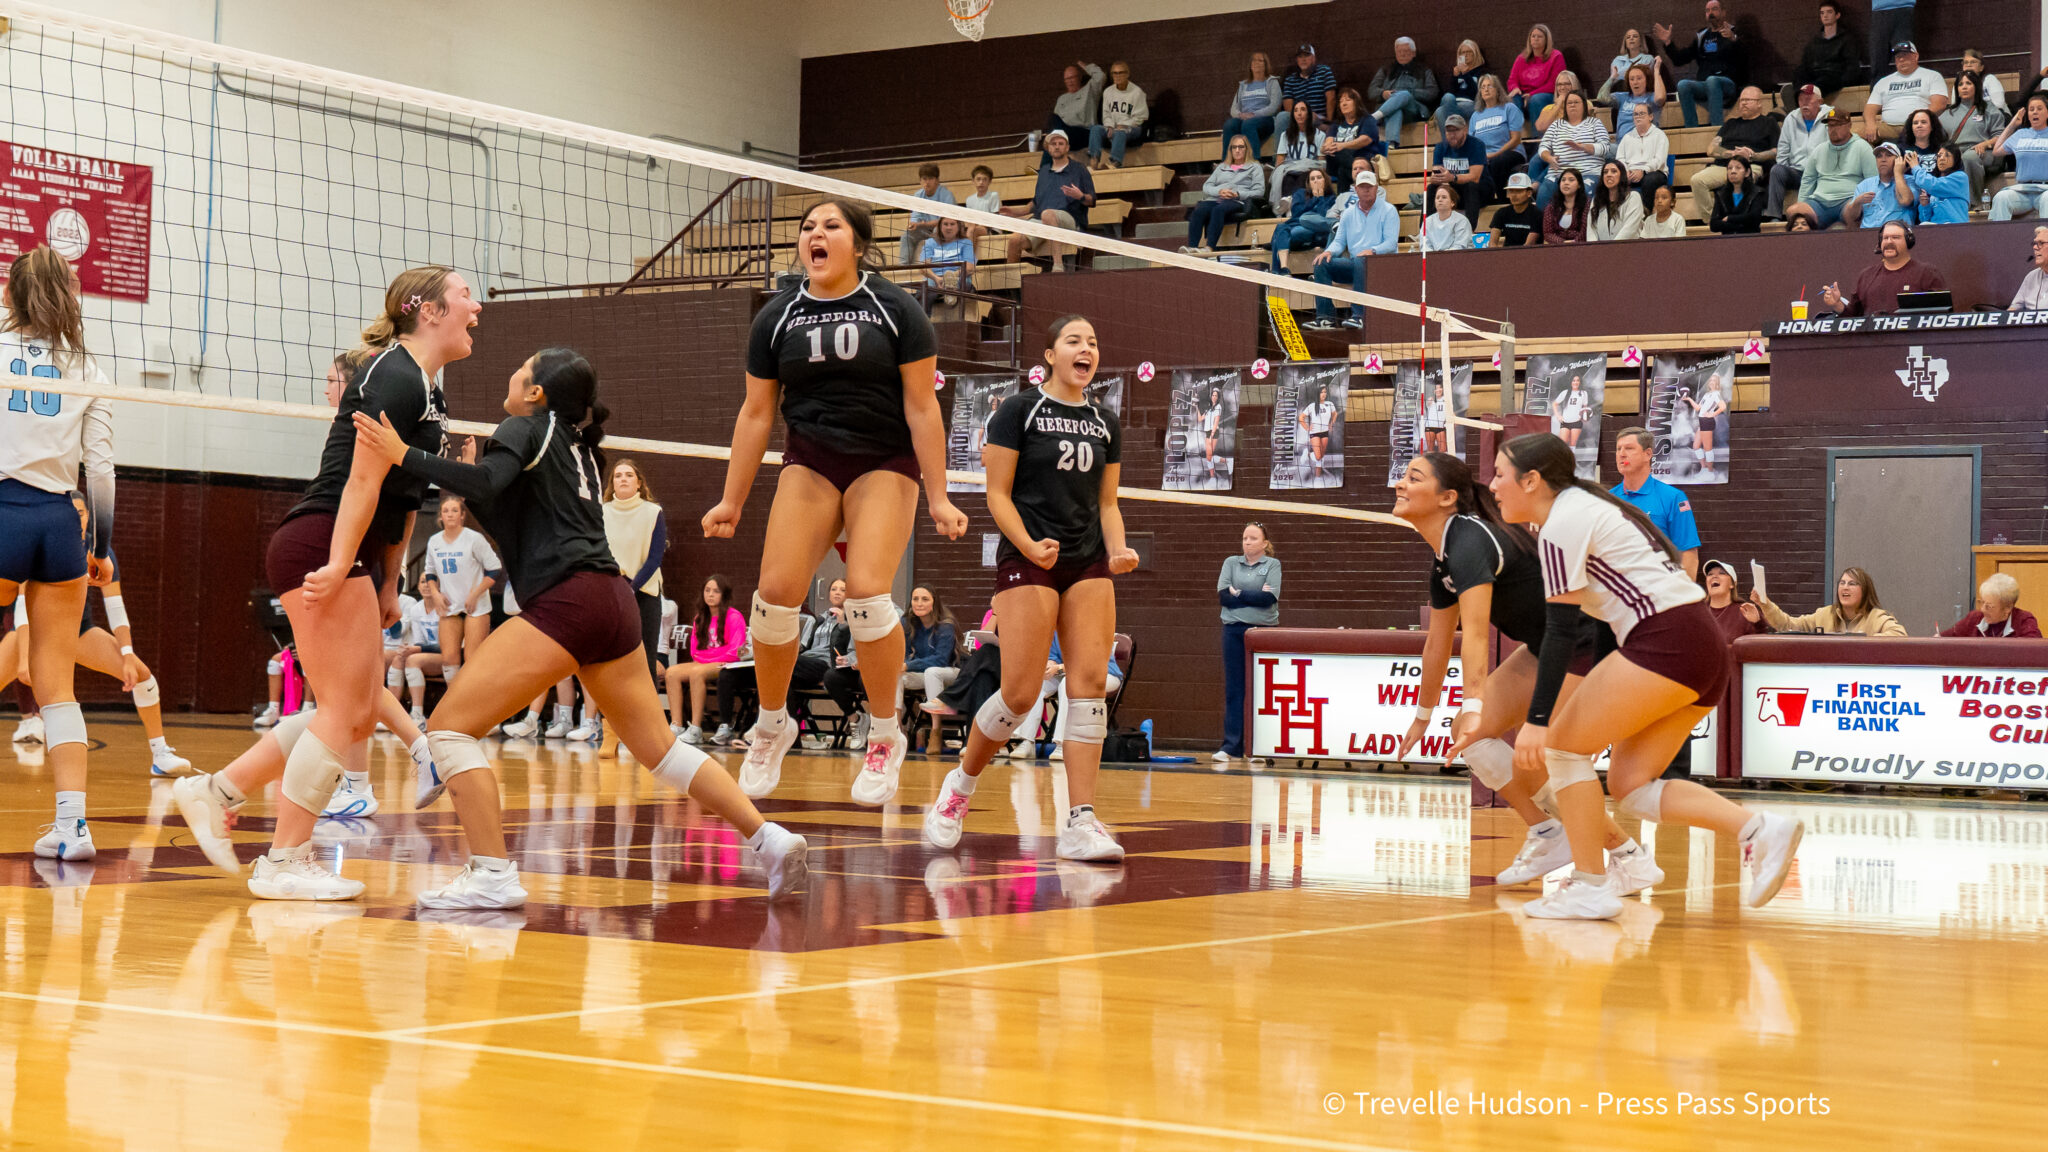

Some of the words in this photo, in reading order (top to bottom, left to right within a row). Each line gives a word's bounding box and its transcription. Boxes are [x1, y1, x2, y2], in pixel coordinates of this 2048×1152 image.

[10, 145, 125, 182] VOLLEYBALL
[83, 179, 124, 195] FINALIST
[56, 226, 81, 240] 2022
[1777, 320, 1835, 335] HOME
[1838, 318, 1866, 332] OF
[1873, 316, 1912, 331] THE
[1917, 311, 2002, 328] HOSTILE
[2006, 310, 2048, 325] HER
[806, 322, 860, 363] 10
[8, 358, 62, 417] 10
[1525, 375, 1552, 417] DEZ
[1036, 416, 1107, 440] HEREFORD
[1165, 389, 1194, 464] LOPEZ
[1273, 385, 1300, 463] HERNANDEZ
[1391, 382, 1421, 461] RAMIREZ
[1645, 376, 1680, 456] SWAN
[1057, 439, 1094, 473] 20
[442, 558, 458, 574] 15
[1389, 661, 1460, 678] Hoe
[1836, 681, 1902, 699] FIRST
[1812, 700, 1926, 717] FINANCIAL
[1838, 717, 1900, 733] BANK
[1791, 750, 1925, 781] Proudly
[1933, 760, 2048, 784] suppo
